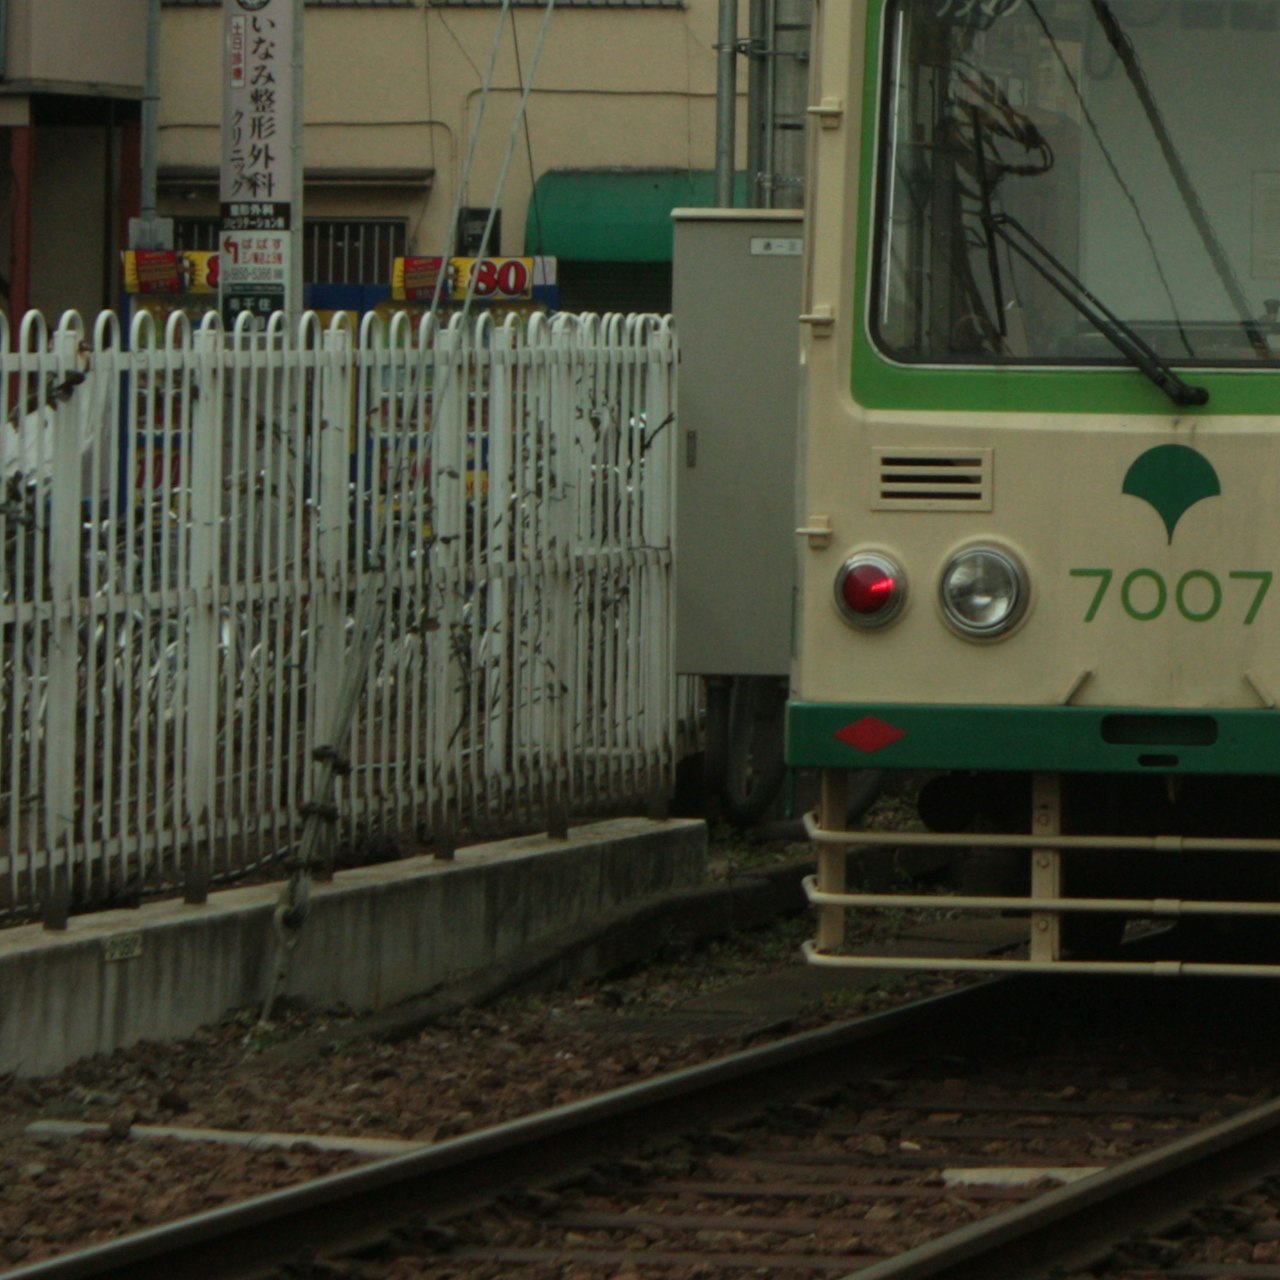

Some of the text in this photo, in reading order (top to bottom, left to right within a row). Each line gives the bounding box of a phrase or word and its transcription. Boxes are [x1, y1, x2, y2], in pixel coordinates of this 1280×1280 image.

[248, 15, 276, 199] いなみ整形外科
[229, 108, 246, 198] クリニック
[1069, 567, 1274, 626] 7007
